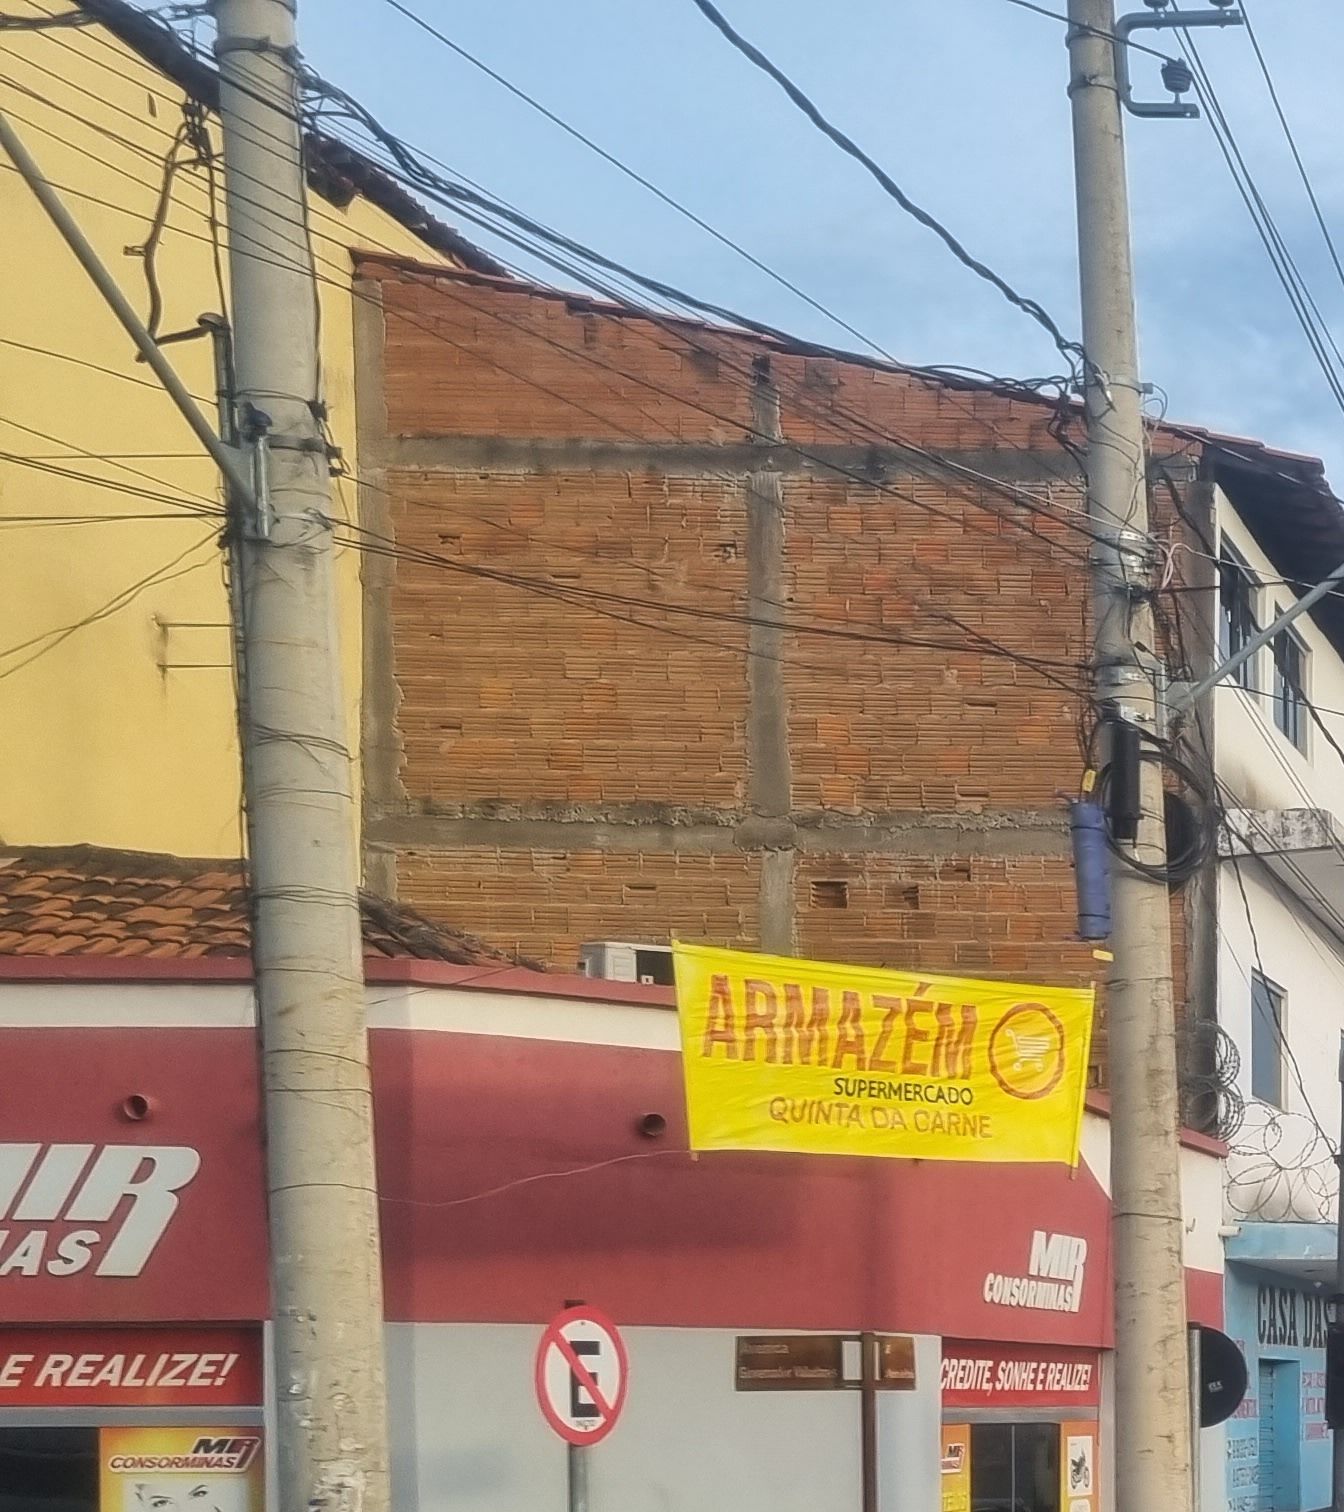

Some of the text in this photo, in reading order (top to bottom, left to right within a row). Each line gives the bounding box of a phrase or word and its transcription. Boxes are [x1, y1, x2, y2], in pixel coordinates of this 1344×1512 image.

[702, 974, 978, 1081] ARMAZÉM
[834, 1077, 974, 1106] SUPERMERCADO
[769, 1096, 993, 1139] QUINTA DA CARNE
[0, 1230, 101, 1276] AS
[1028, 1230, 1087, 1313] MIR
[984, 1272, 1074, 1312] CONSORMINAS
[1257, 1285, 1298, 1345] CASA
[0, 1353, 240, 1388] E REALIZE!
[995, 1361, 1037, 1391] SONHE
[1035, 1362, 1047, 1391] E
[1046, 1362, 1092, 1391] REALIZE!
[110, 1456, 236, 1468] CONSORMINAS
